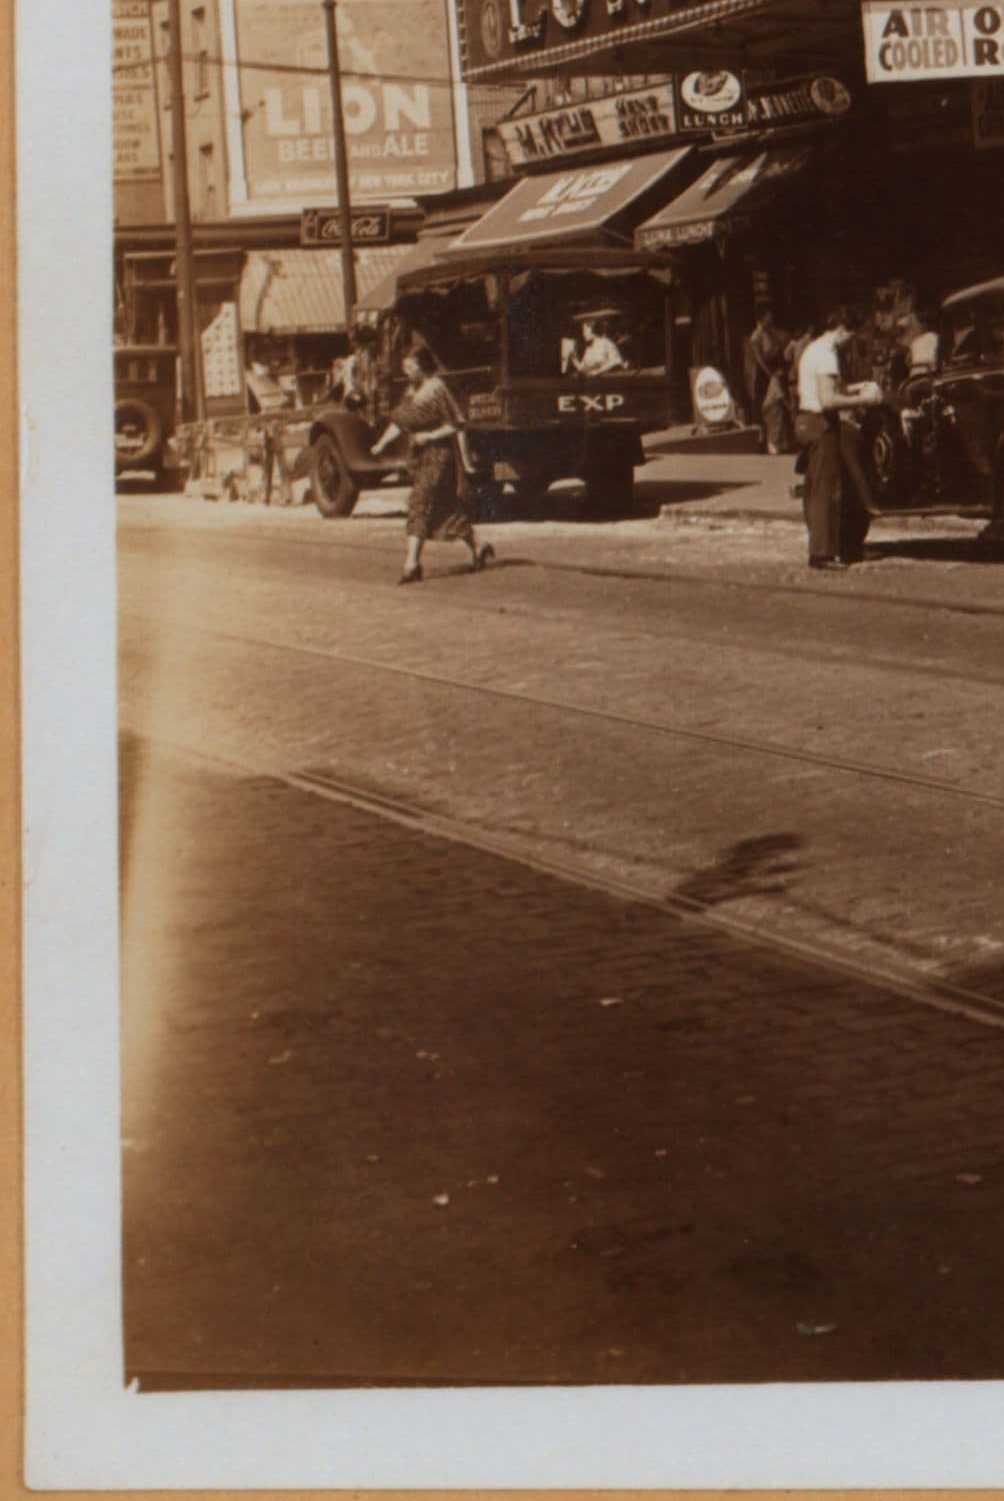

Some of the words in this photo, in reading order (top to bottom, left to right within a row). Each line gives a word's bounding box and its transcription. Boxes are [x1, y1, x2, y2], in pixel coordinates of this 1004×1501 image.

[882, 7, 950, 38] AIR
[879, 37, 958, 71] COOLED
[264, 84, 432, 137] LION
[684, 113, 743, 128] LUNCH
[382, 131, 429, 157] ALE
[558, 394, 625, 412] EXP
